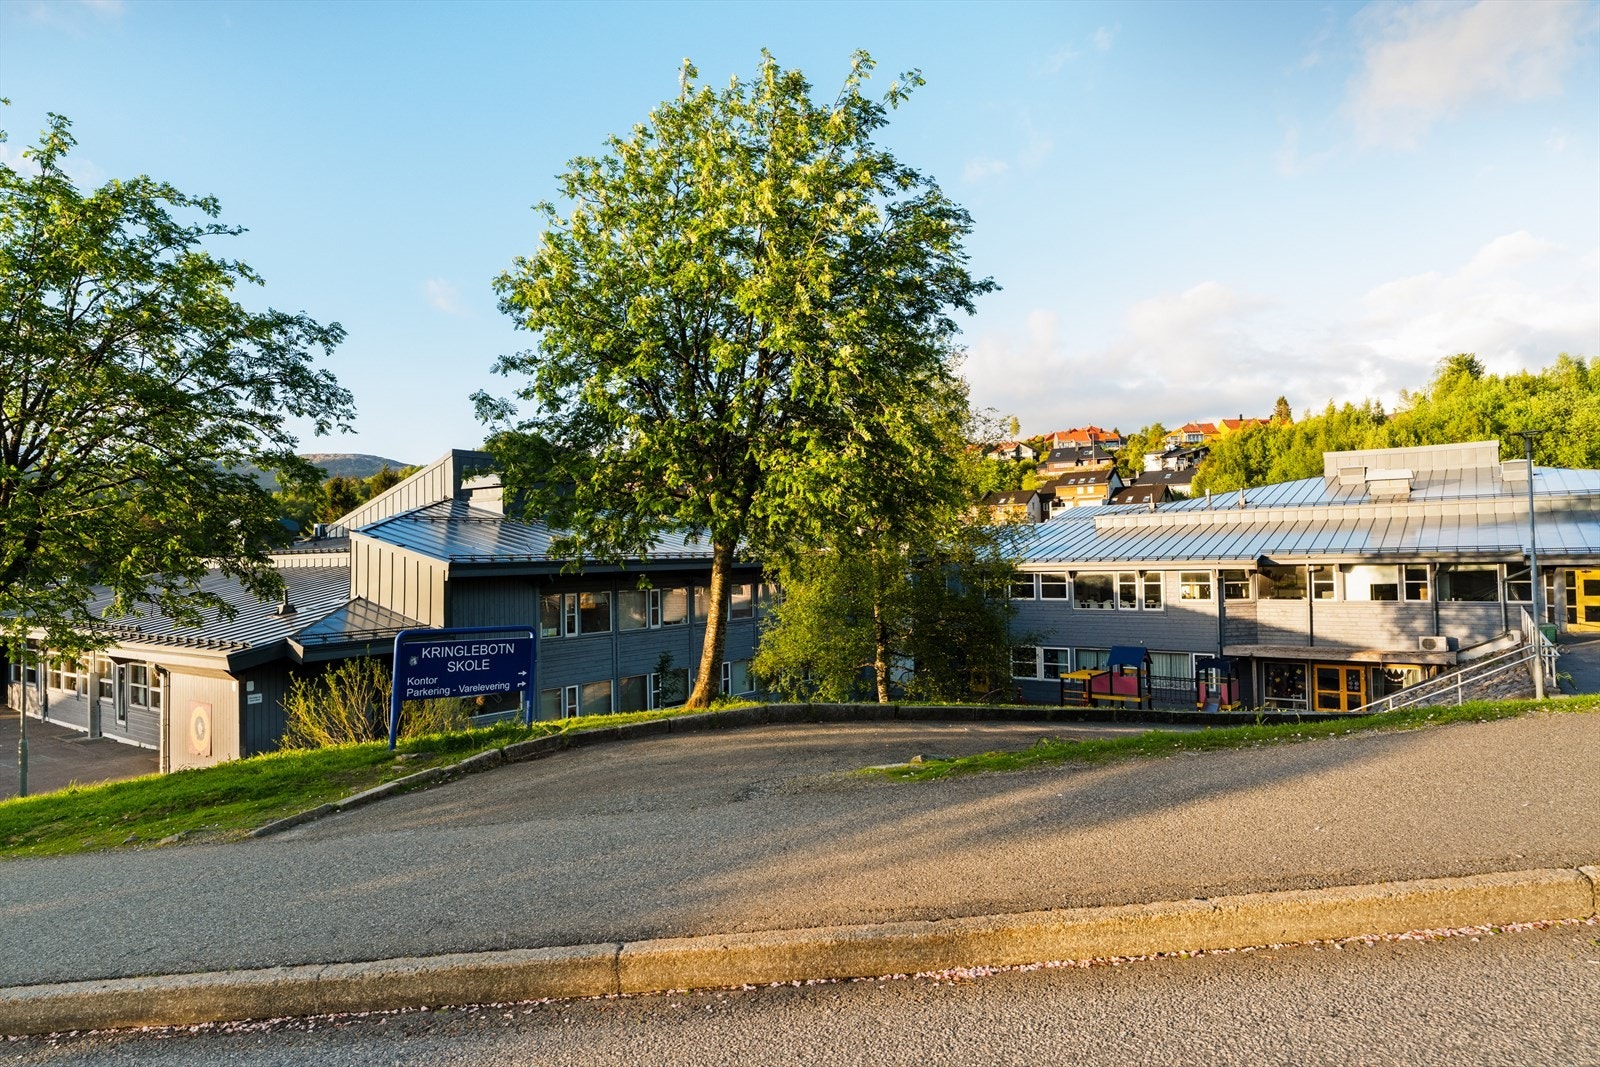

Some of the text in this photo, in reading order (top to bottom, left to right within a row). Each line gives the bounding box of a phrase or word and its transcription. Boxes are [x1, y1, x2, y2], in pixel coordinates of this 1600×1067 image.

[421, 643, 515, 659] KRINGLEBOTN
[447, 659, 490, 672] SKOLE
[407, 676, 438, 686] Kontor
[406, 687, 450, 697] Parkering
[458, 682, 510, 693] Varelevering
